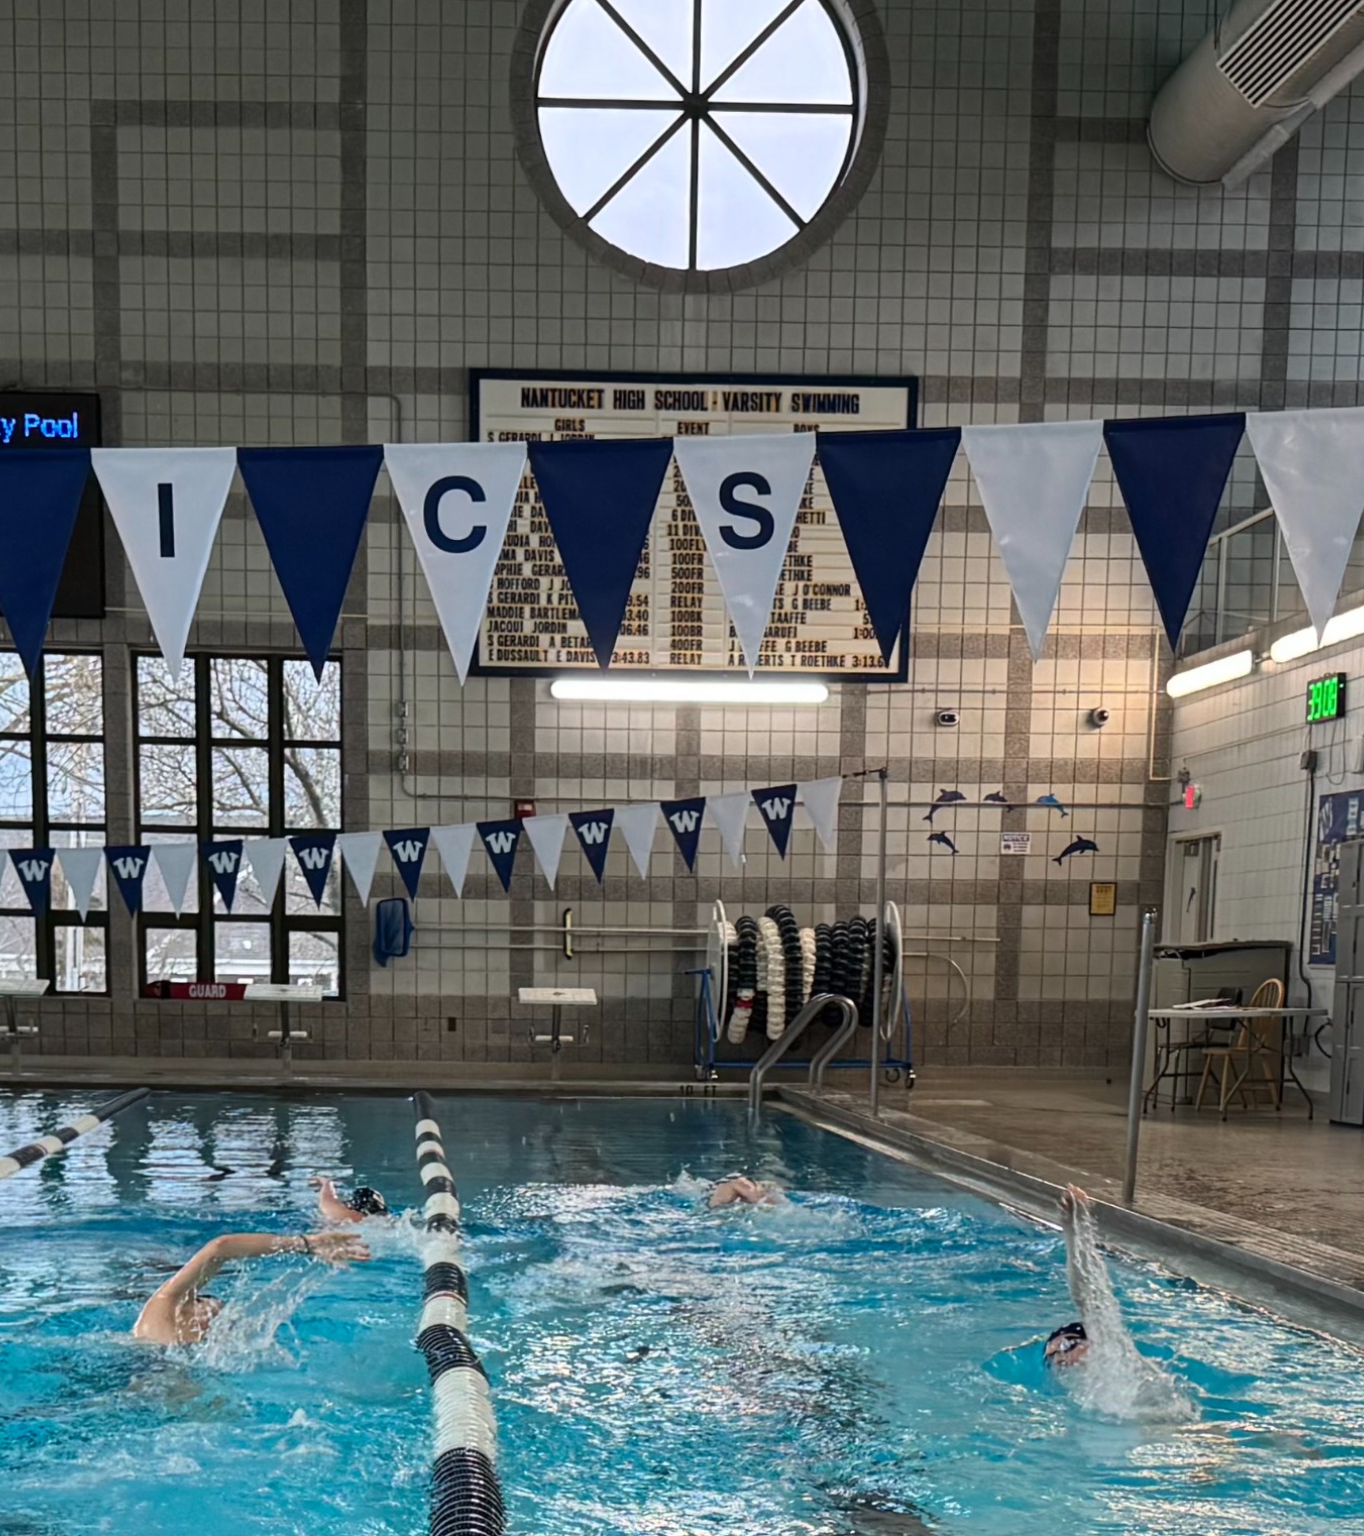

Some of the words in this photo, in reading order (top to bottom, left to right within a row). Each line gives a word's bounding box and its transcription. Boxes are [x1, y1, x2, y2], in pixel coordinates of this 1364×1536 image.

[521, 387, 604, 409] NANTUCKET
[613, 389, 645, 410] HIGH
[654, 390, 708, 411] SCHOOL
[722, 391, 782, 413] VARSITY
[791, 393, 860, 414] SWIMMING
[24, 412, 78, 438] Pool
[554, 418, 585, 432] GIRLS
[677, 421, 710, 435] EVENT
[524, 549, 555, 562] DAVIS
[671, 553, 704, 565] 100FR
[531, 564, 565, 576] GERAR
[671, 567, 704, 580] 500FR
[497, 577, 540, 590] HOFFORD
[549, 579, 554, 591] J
[671, 581, 704, 594] 200FR
[793, 584, 799, 596] J
[803, 584, 851, 596] O'CONNOR
[497, 591, 540, 605] GERARDI
[547, 593, 554, 605] K
[558, 594, 576, 606] PIT
[670, 595, 703, 609] RELAY
[802, 598, 832, 611] BEEBE
[486, 606, 524, 619] MADDIE
[624, 609, 649, 622] 3.40
[670, 610, 703, 623] 100BK
[771, 612, 806, 625] TAAFFE
[486, 621, 524, 633] JACQUI
[532, 621, 568, 634] JORDIN
[670, 625, 703, 637] 100BR
[853, 627, 876, 639] 1:00
[487, 635, 494, 647] S
[497, 635, 540, 648] GERARDI
[548, 635, 556, 648] A
[669, 639, 703, 652] 400FR
[729, 640, 735, 652] J
[785, 640, 792, 653] G
[795, 641, 828, 653] BEEBE
[489, 649, 494, 661] E
[497, 649, 548, 662] DUSSAULT
[556, 650, 562, 663] E
[566, 650, 596, 663] DAVIS
[611, 651, 650, 664] 3:43.83
[669, 652, 702, 665] RELAY
[728, 654, 735, 666] A
[791, 655, 797, 667] T
[801, 655, 846, 668] ROETHKE
[852, 655, 885, 668] 3:13.6
[762, 798, 790, 819] W
[670, 811, 698, 832] W
[579, 823, 607, 843] W
[487, 833, 515, 853] W
[300, 848, 327, 868] W
[394, 841, 422, 861] W
[114, 858, 142, 878] W
[209, 853, 237, 872] W
[20, 861, 47, 880] W
[189, 984, 227, 998] GUARD
